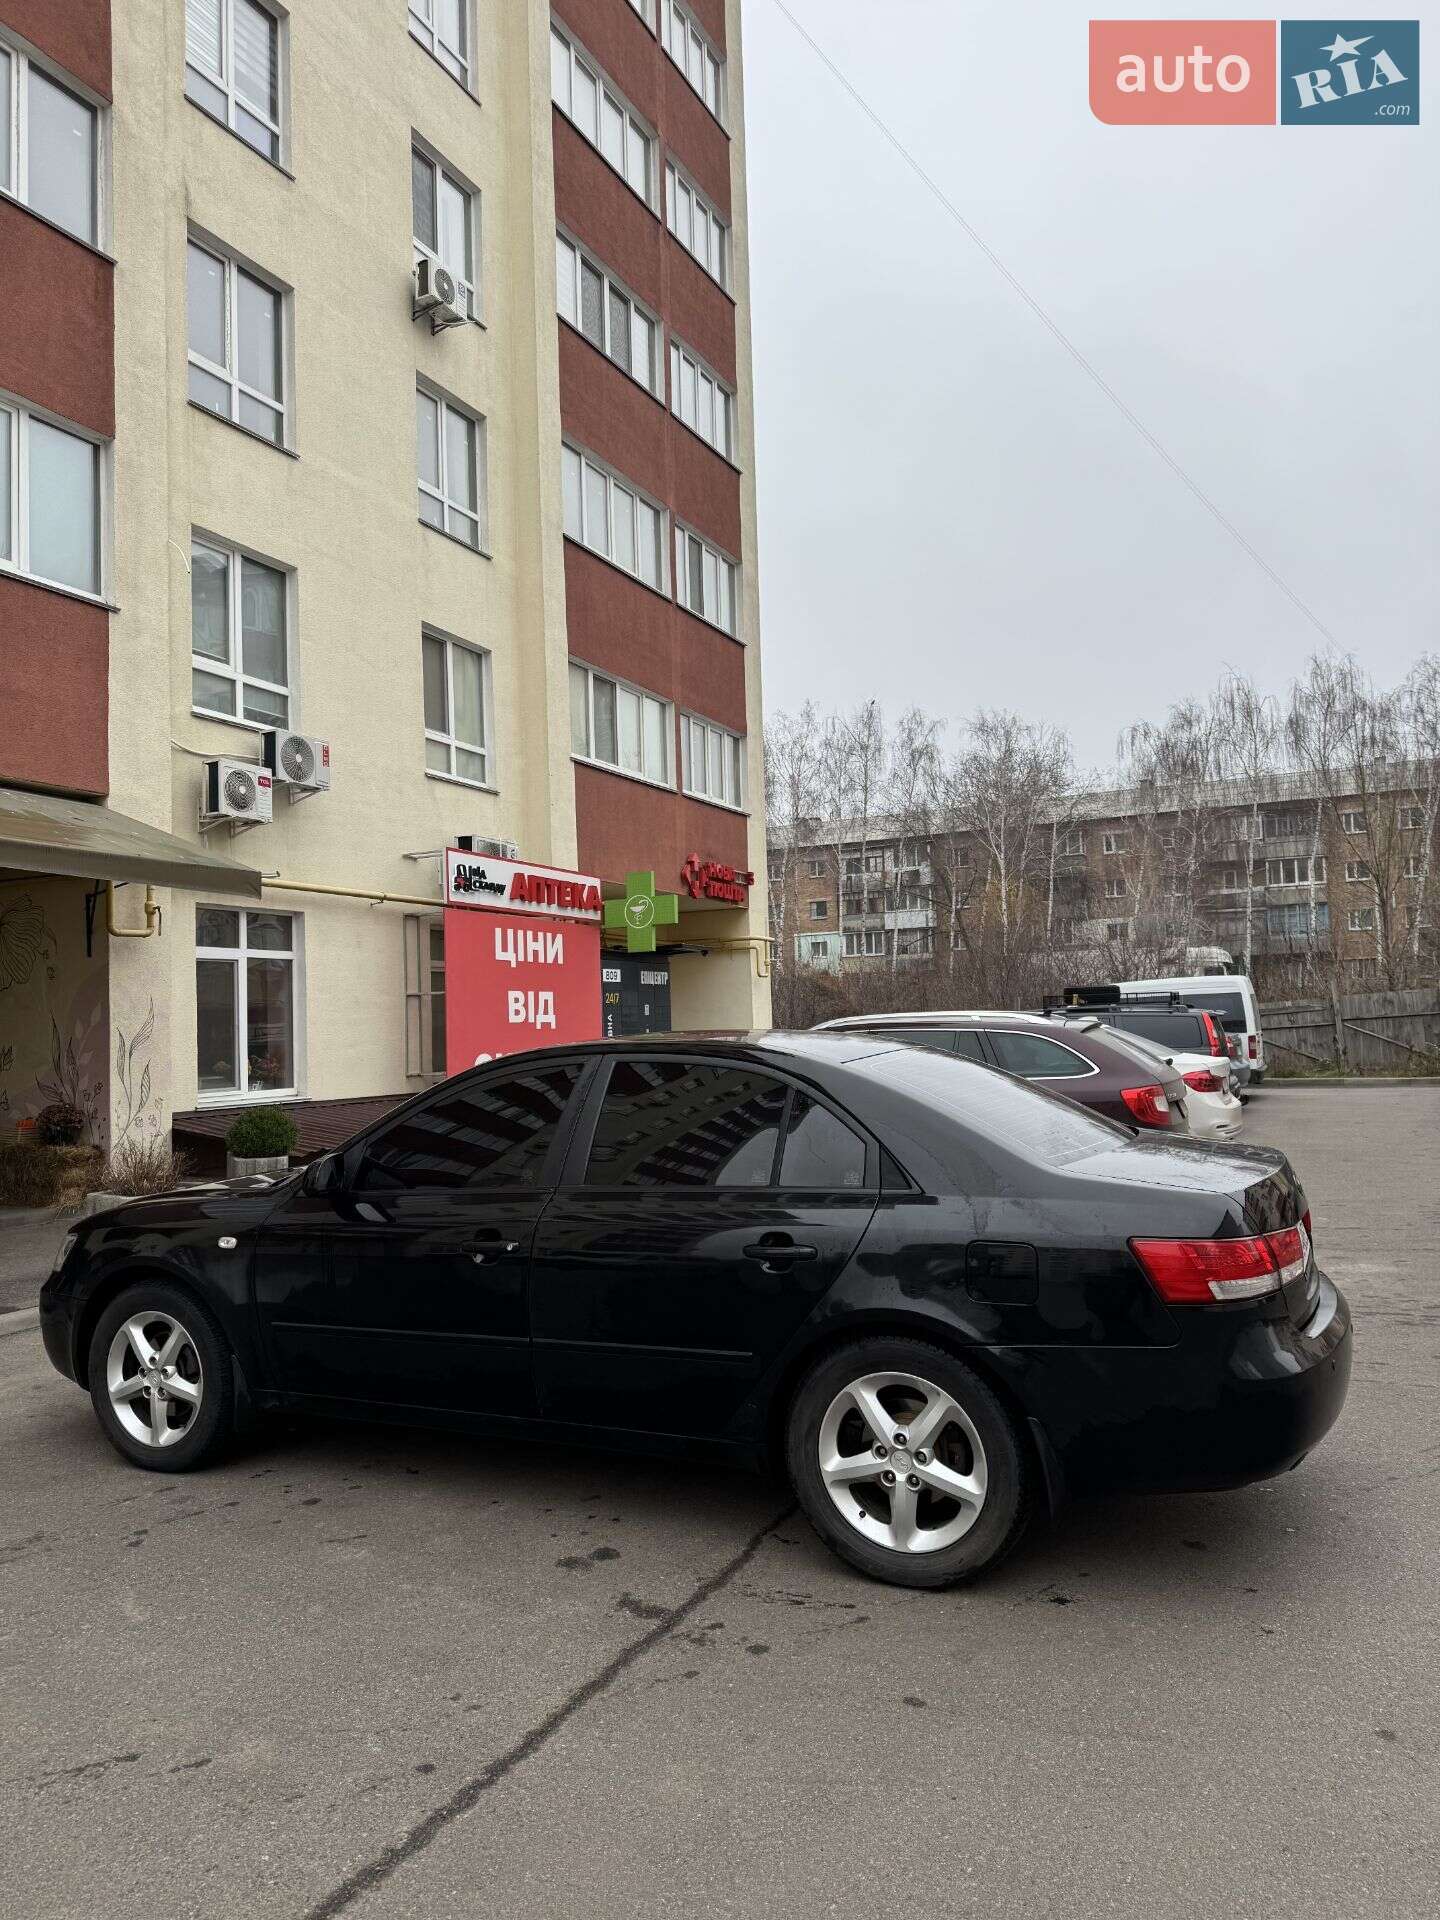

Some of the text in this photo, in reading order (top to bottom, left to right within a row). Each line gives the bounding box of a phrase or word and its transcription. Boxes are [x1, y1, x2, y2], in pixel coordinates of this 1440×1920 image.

[510, 872, 601, 911] АПТЕКА
[494, 927, 564, 968] ЦІНИ
[508, 990, 556, 1029] ВІД
